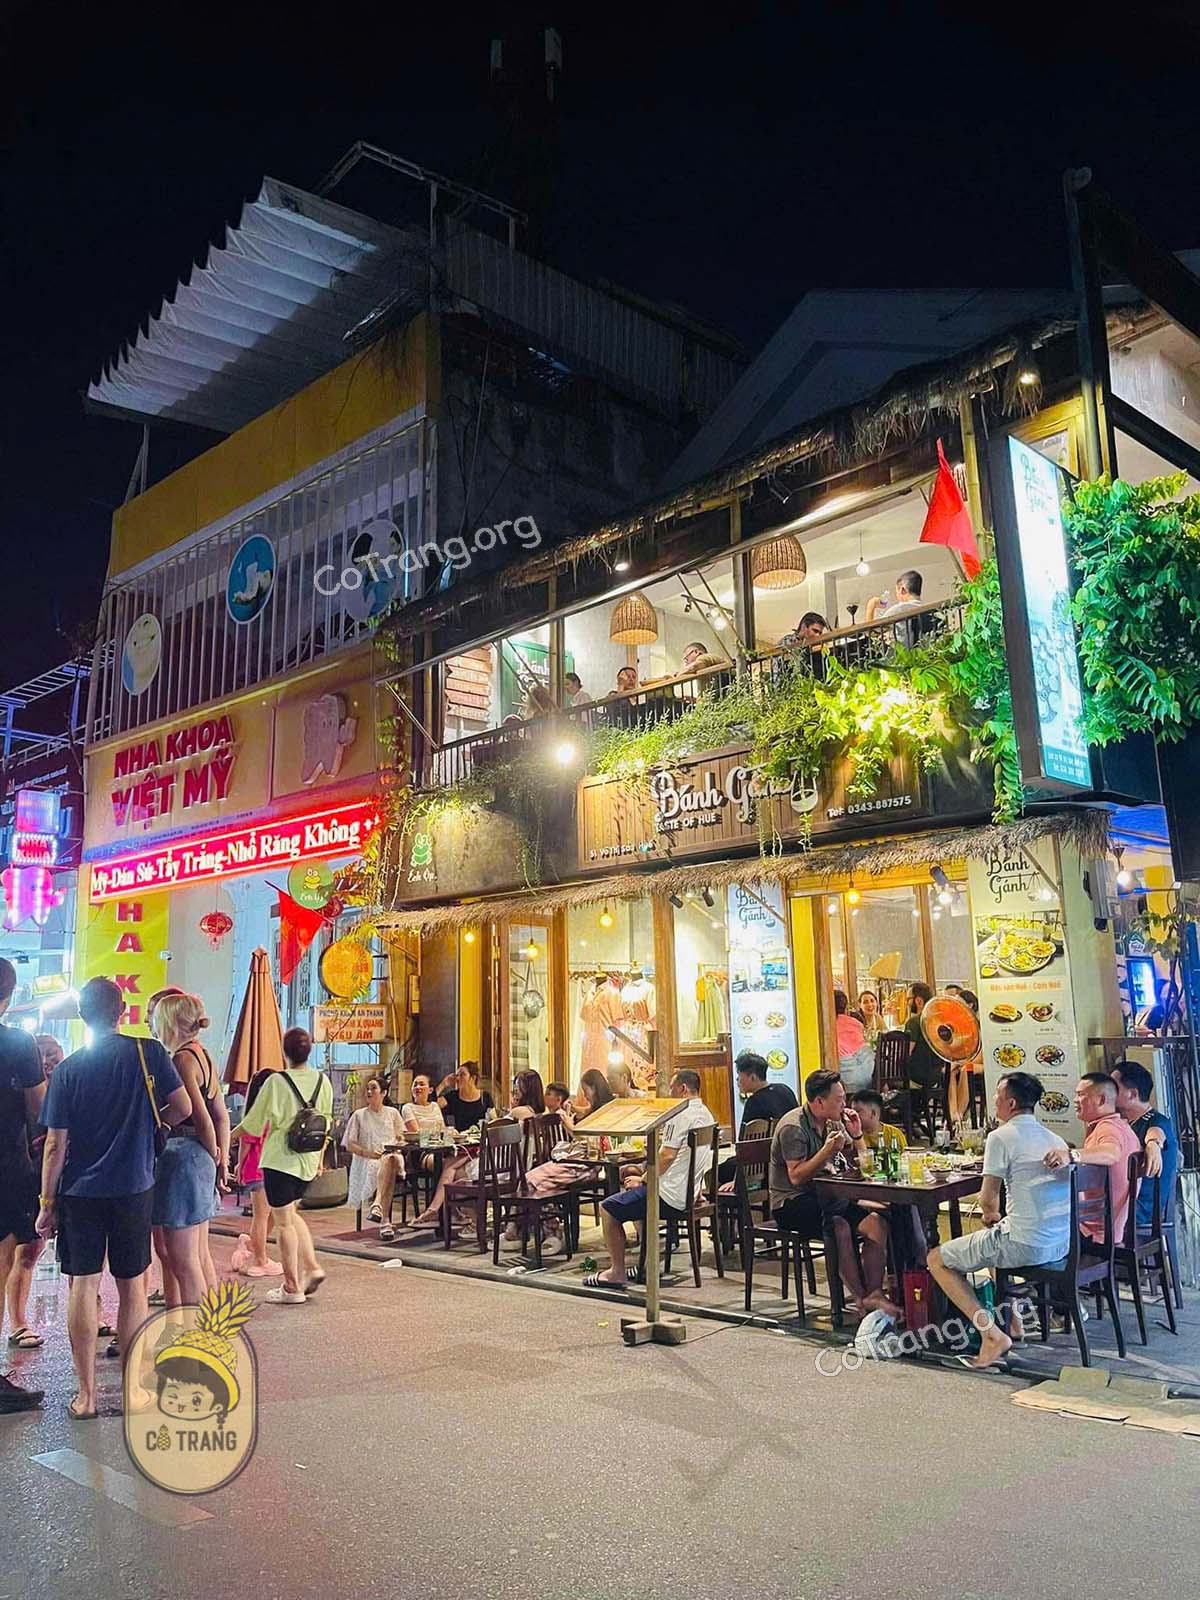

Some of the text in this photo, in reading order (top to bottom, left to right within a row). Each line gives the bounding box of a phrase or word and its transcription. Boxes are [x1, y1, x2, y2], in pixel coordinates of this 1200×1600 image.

[166, 714, 236, 762] KHOA
[111, 773, 176, 830] VIỆT
[652, 770, 723, 822] Bánh
[847, 795, 912, 814] 0343-887575
[683, 816, 695, 826] OF
[699, 813, 717, 823] HUE
[260, 833, 301, 857] Răng
[304, 820, 361, 853] Không
[984, 849, 1030, 876] Bánh
[989, 873, 1030, 904] Gánh
[738, 906, 768, 929] Gánh
